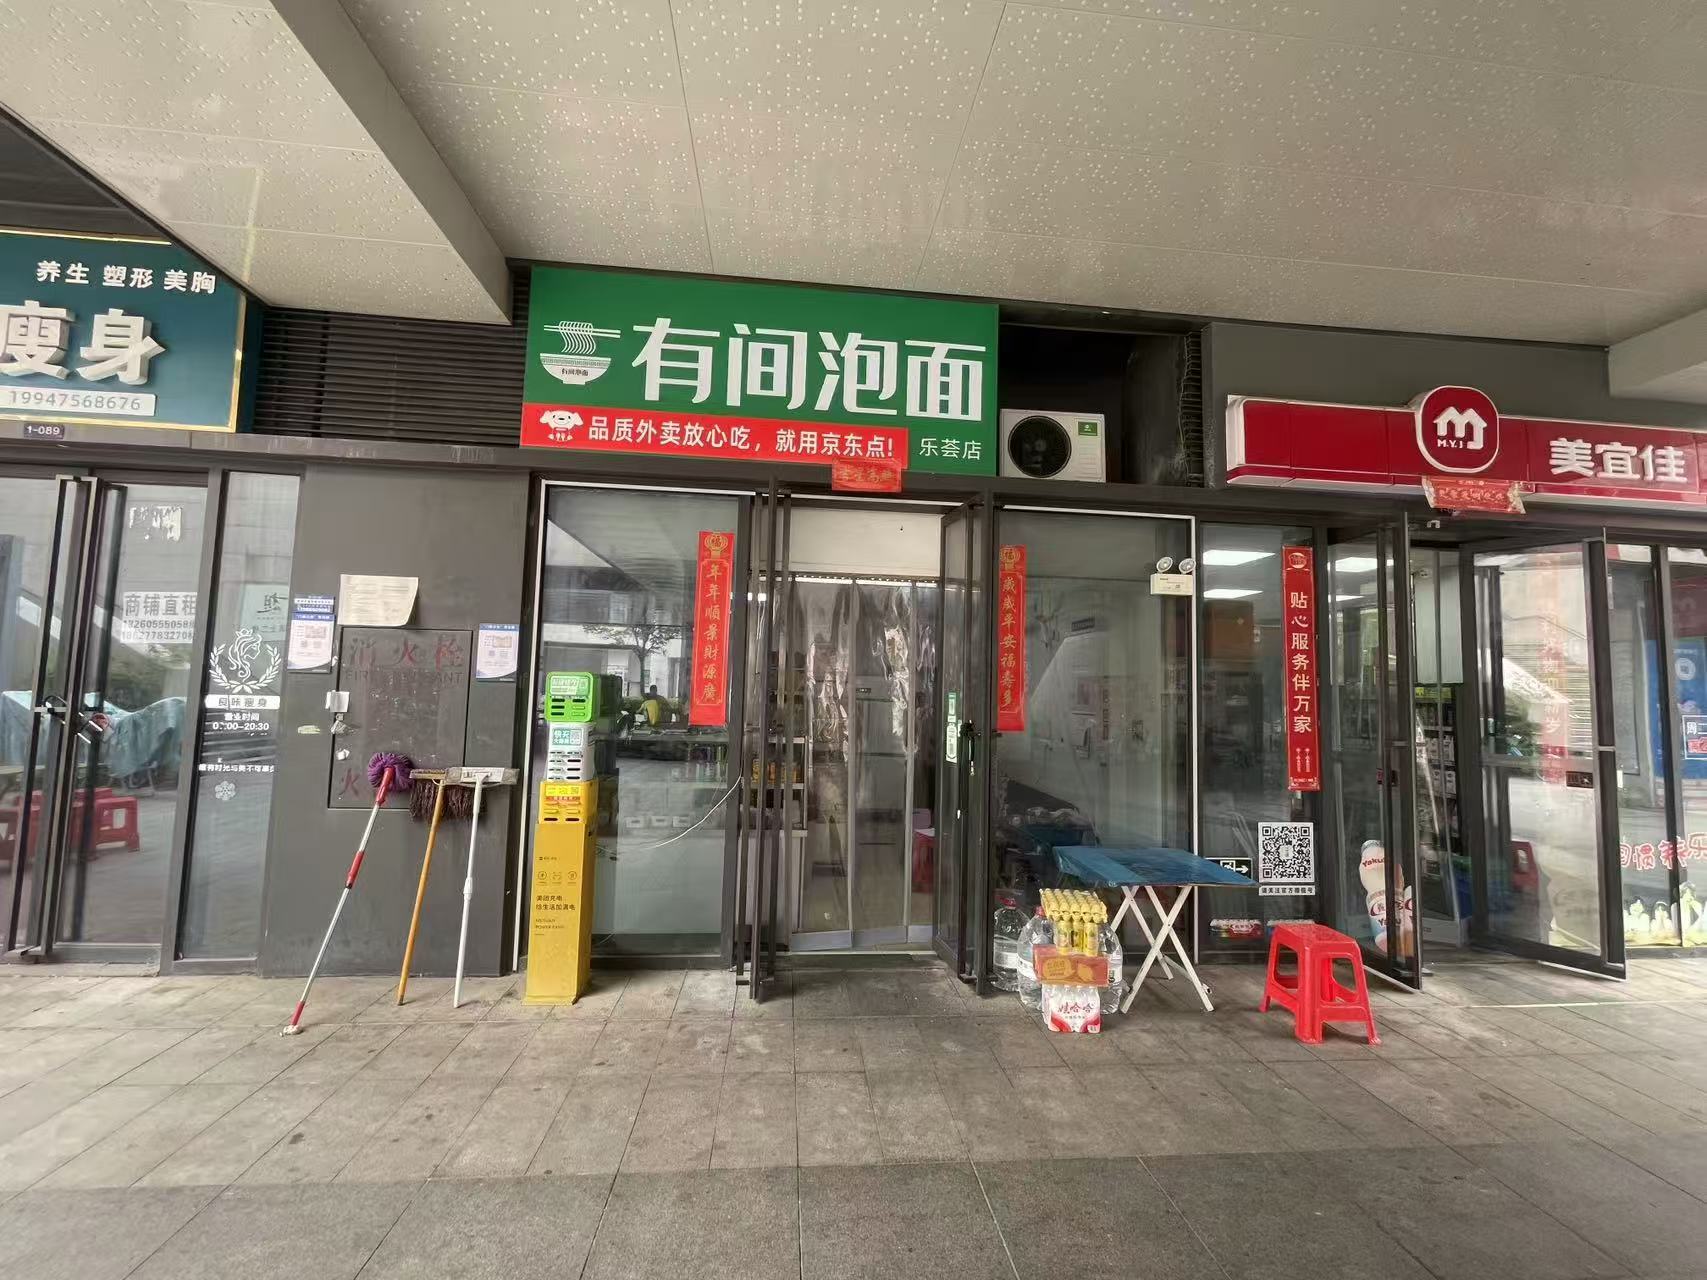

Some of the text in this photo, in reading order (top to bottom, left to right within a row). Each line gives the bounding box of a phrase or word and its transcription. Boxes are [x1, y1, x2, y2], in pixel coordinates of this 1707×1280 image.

[37, 260, 216, 294] 养生 塑形 美胸
[0, 300, 167, 385] 瘦身
[632, 317, 987, 421] 有间泡面
[10, 390, 141, 411] 19947568676
[27, 425, 61, 436] 1-089
[919, 437, 982, 460] 乐荟店
[1549, 437, 1688, 483] 美宜佳
[1290, 592, 1312, 734] 贴心服务伴万家
